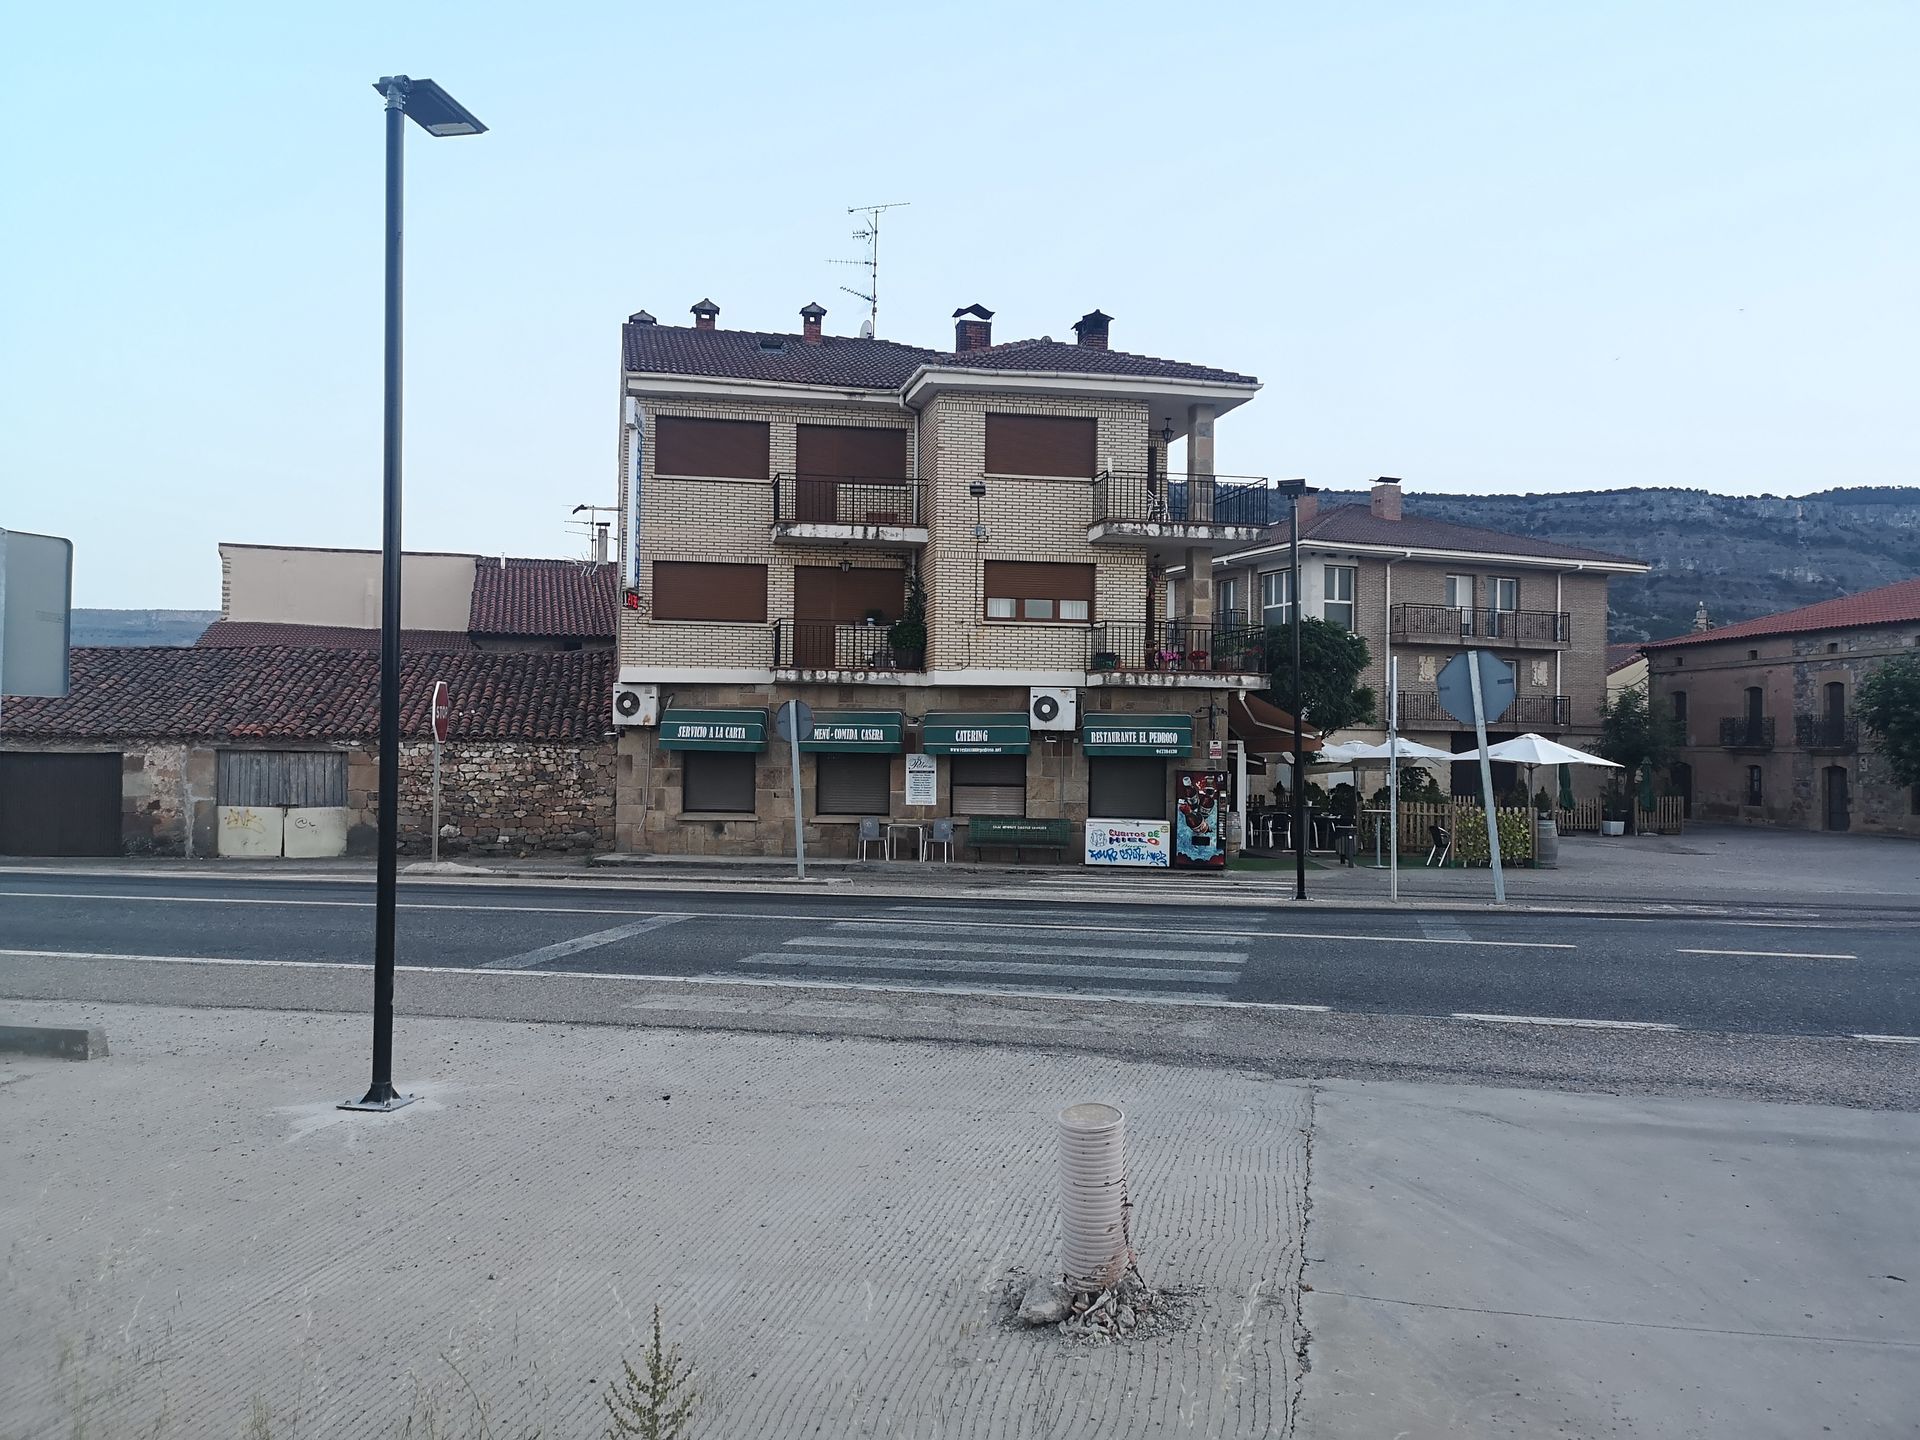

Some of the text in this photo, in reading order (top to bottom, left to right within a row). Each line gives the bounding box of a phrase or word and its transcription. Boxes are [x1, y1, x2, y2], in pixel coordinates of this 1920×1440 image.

[436, 705, 448, 719] STOP
[677, 726, 746, 739] SERVICIO A LA CARTA
[861, 728, 883, 740] CASERA
[955, 729, 988, 742] CATERING
[1091, 731, 1178, 744] RESTAURANTE EL PEDROSO
[1109, 829, 1146, 838] CUBITOS
[1109, 837, 1160, 846] HIELO
